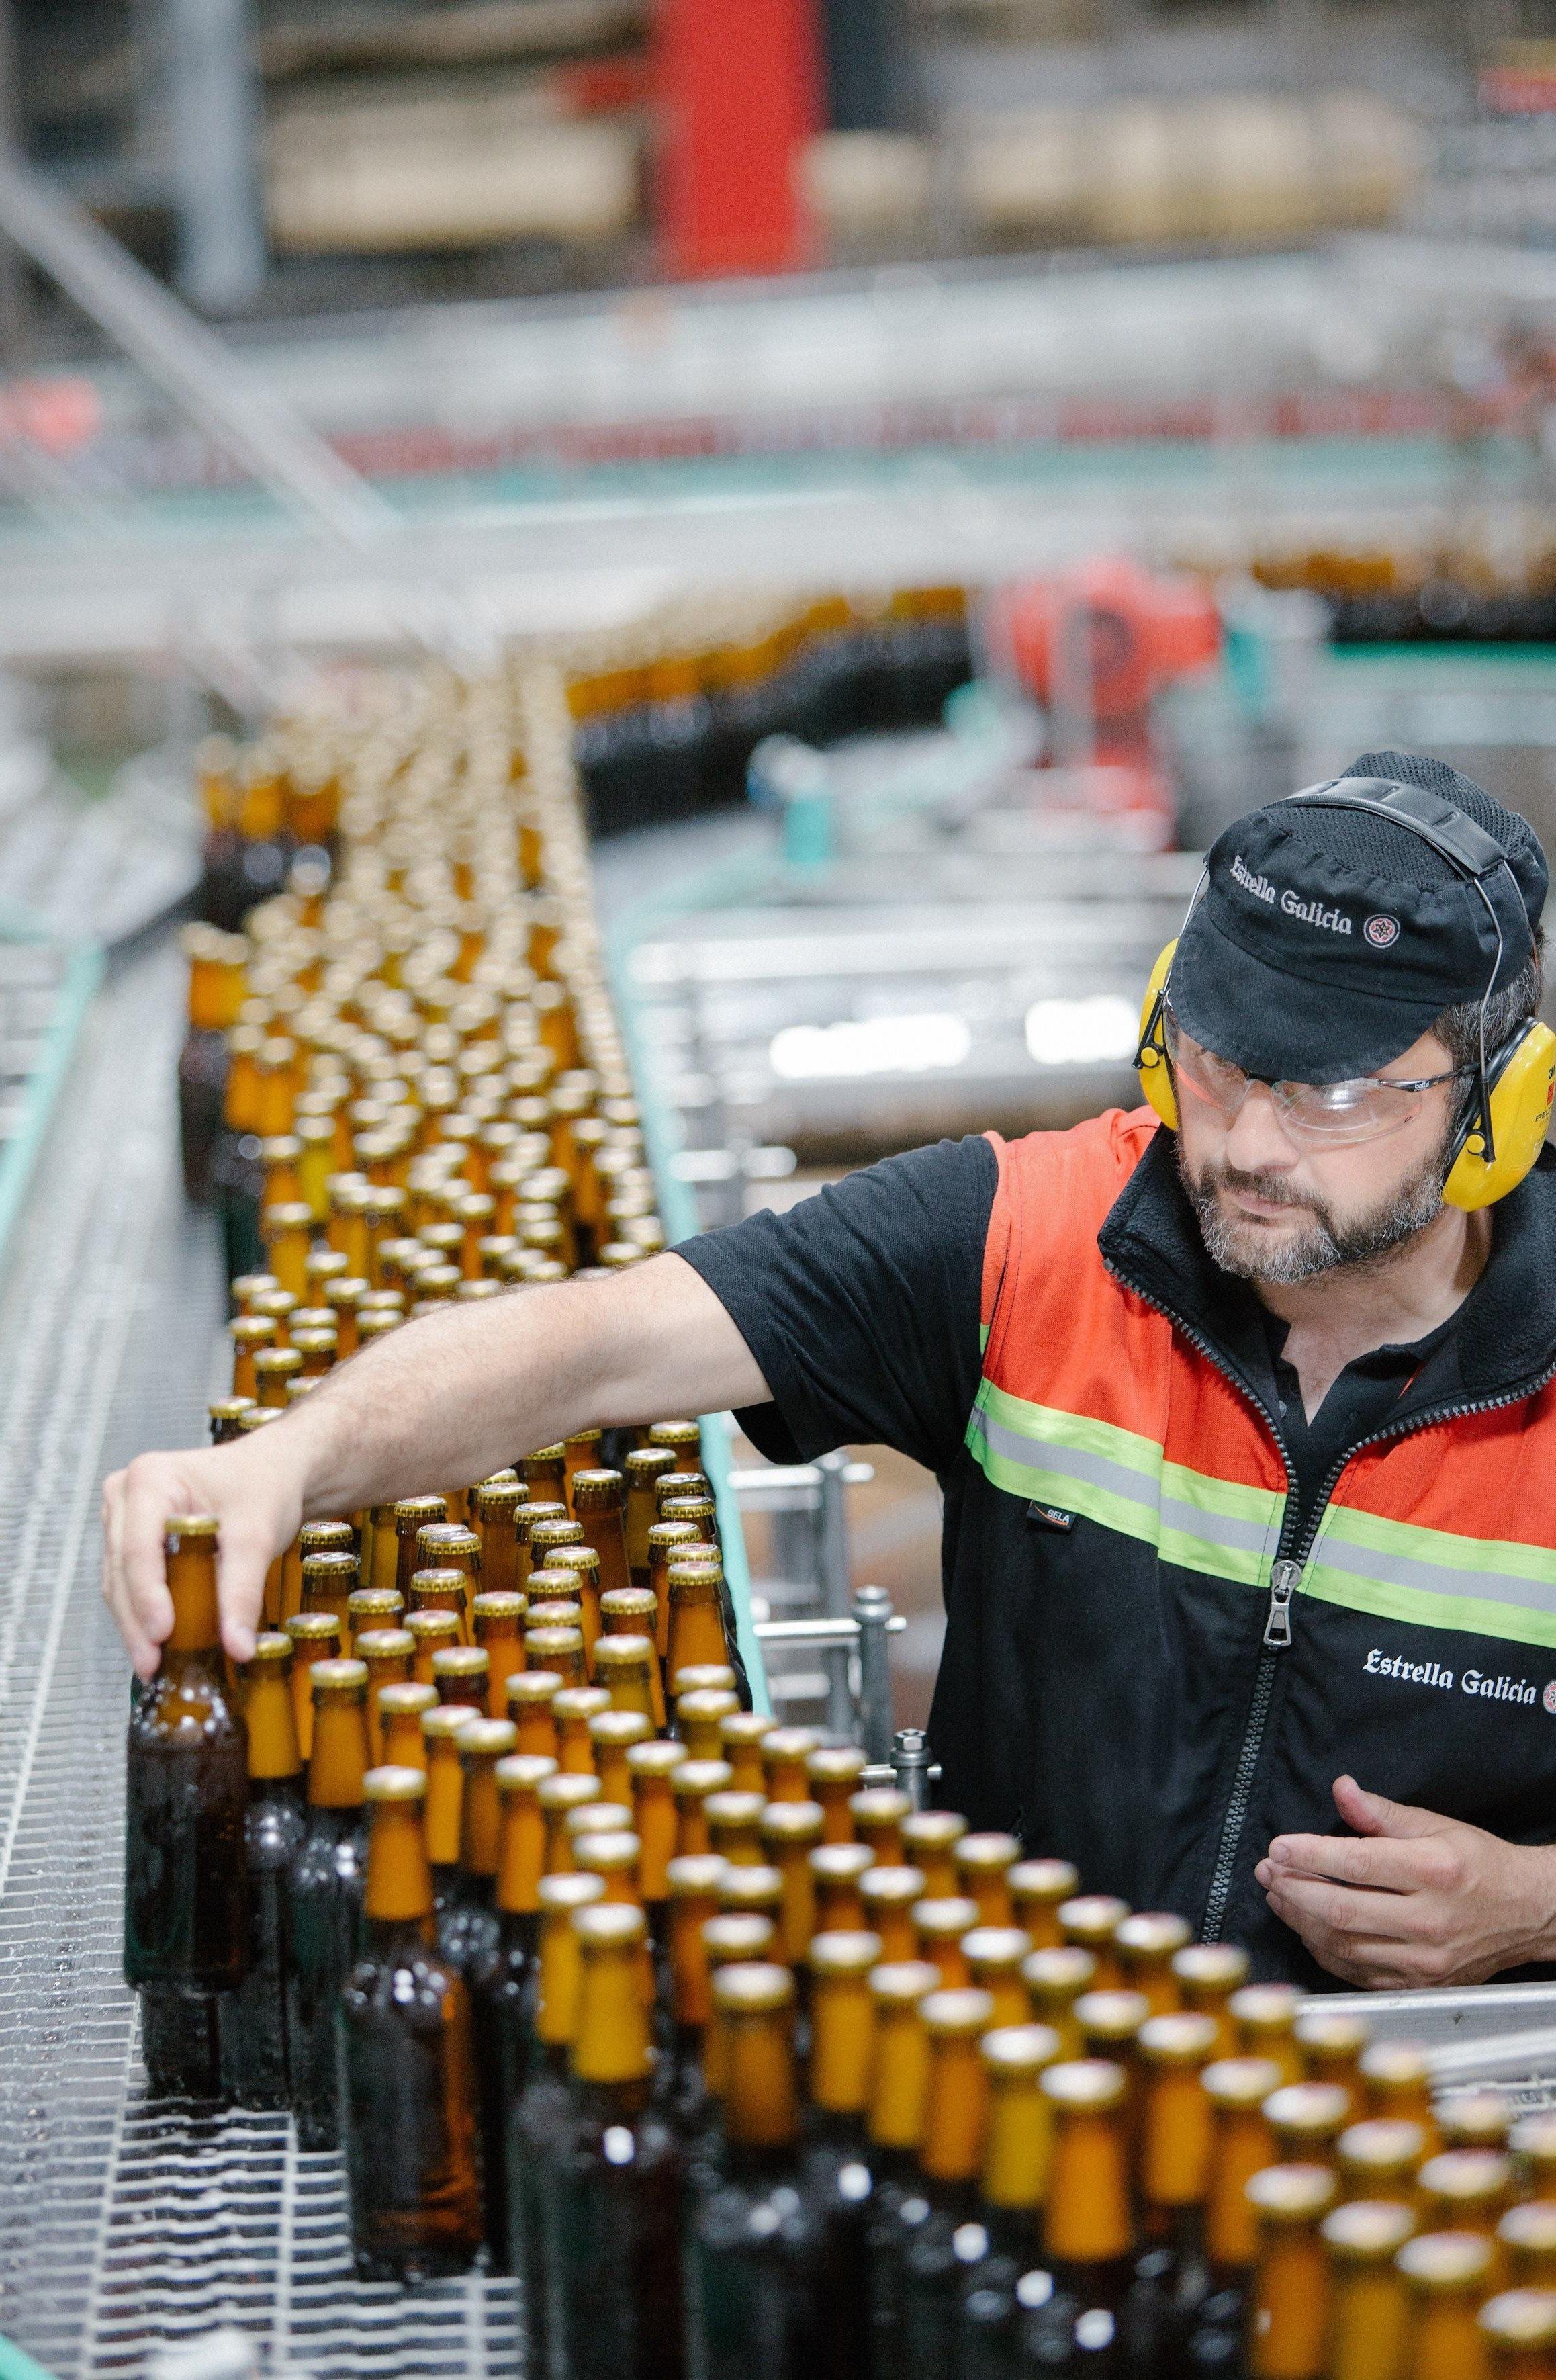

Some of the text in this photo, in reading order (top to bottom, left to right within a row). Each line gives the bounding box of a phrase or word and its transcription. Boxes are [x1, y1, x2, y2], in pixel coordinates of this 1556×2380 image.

[1230, 854, 1352, 935] Estrella Galicia
[1046, 1509, 1070, 1524] SELA
[1362, 1648, 1537, 1705] Estrella Galicia
